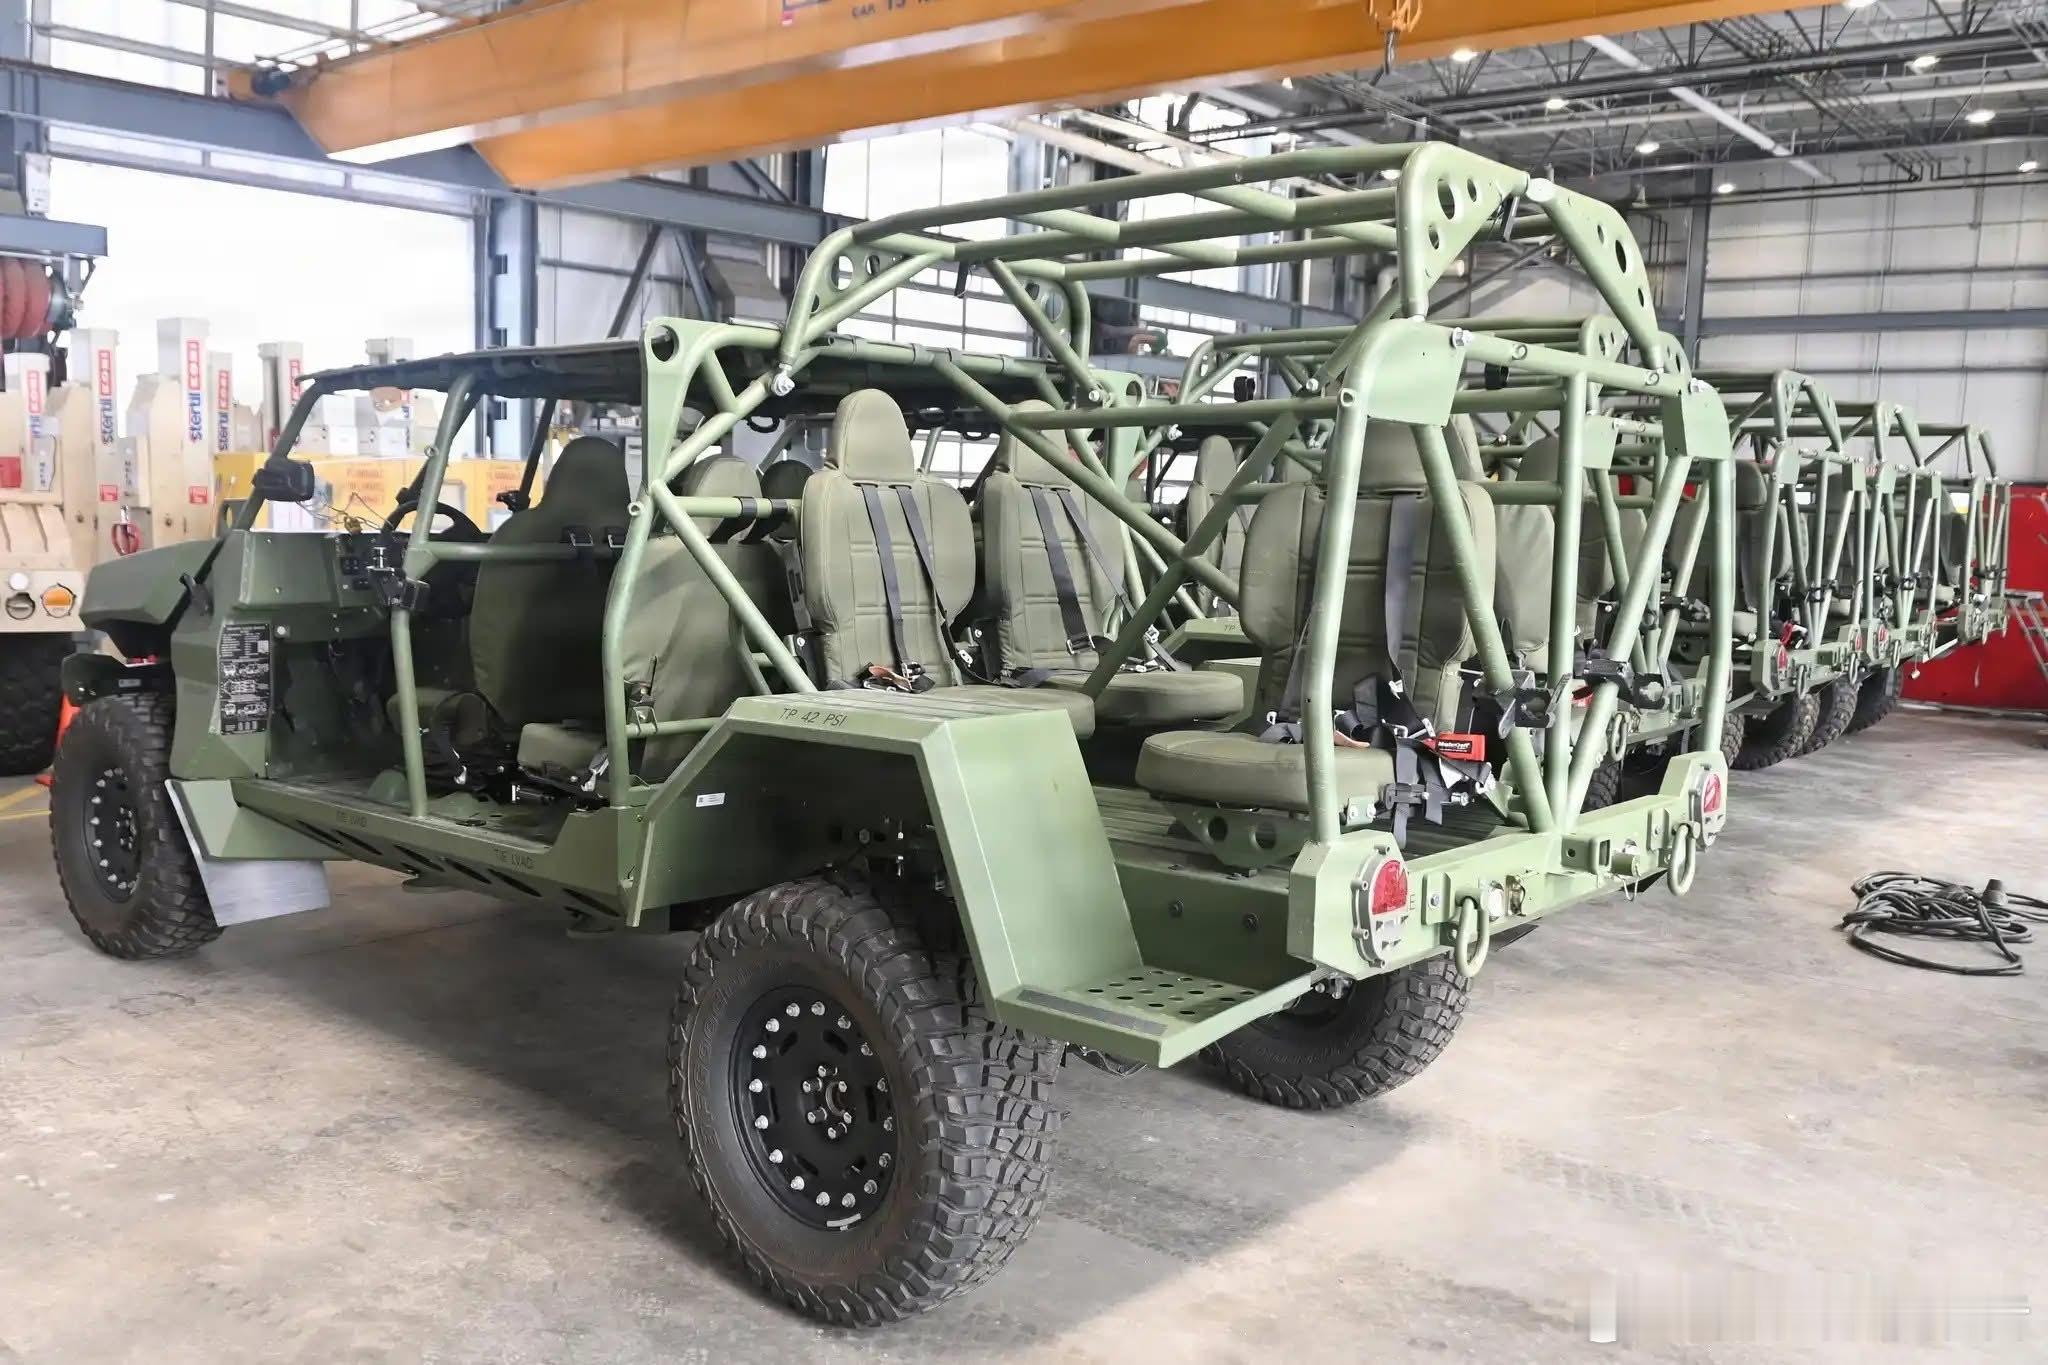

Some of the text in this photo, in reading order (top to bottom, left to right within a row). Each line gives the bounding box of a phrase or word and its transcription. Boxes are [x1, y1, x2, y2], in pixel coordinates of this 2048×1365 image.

[778, 708, 848, 728] TP 42 PSI
